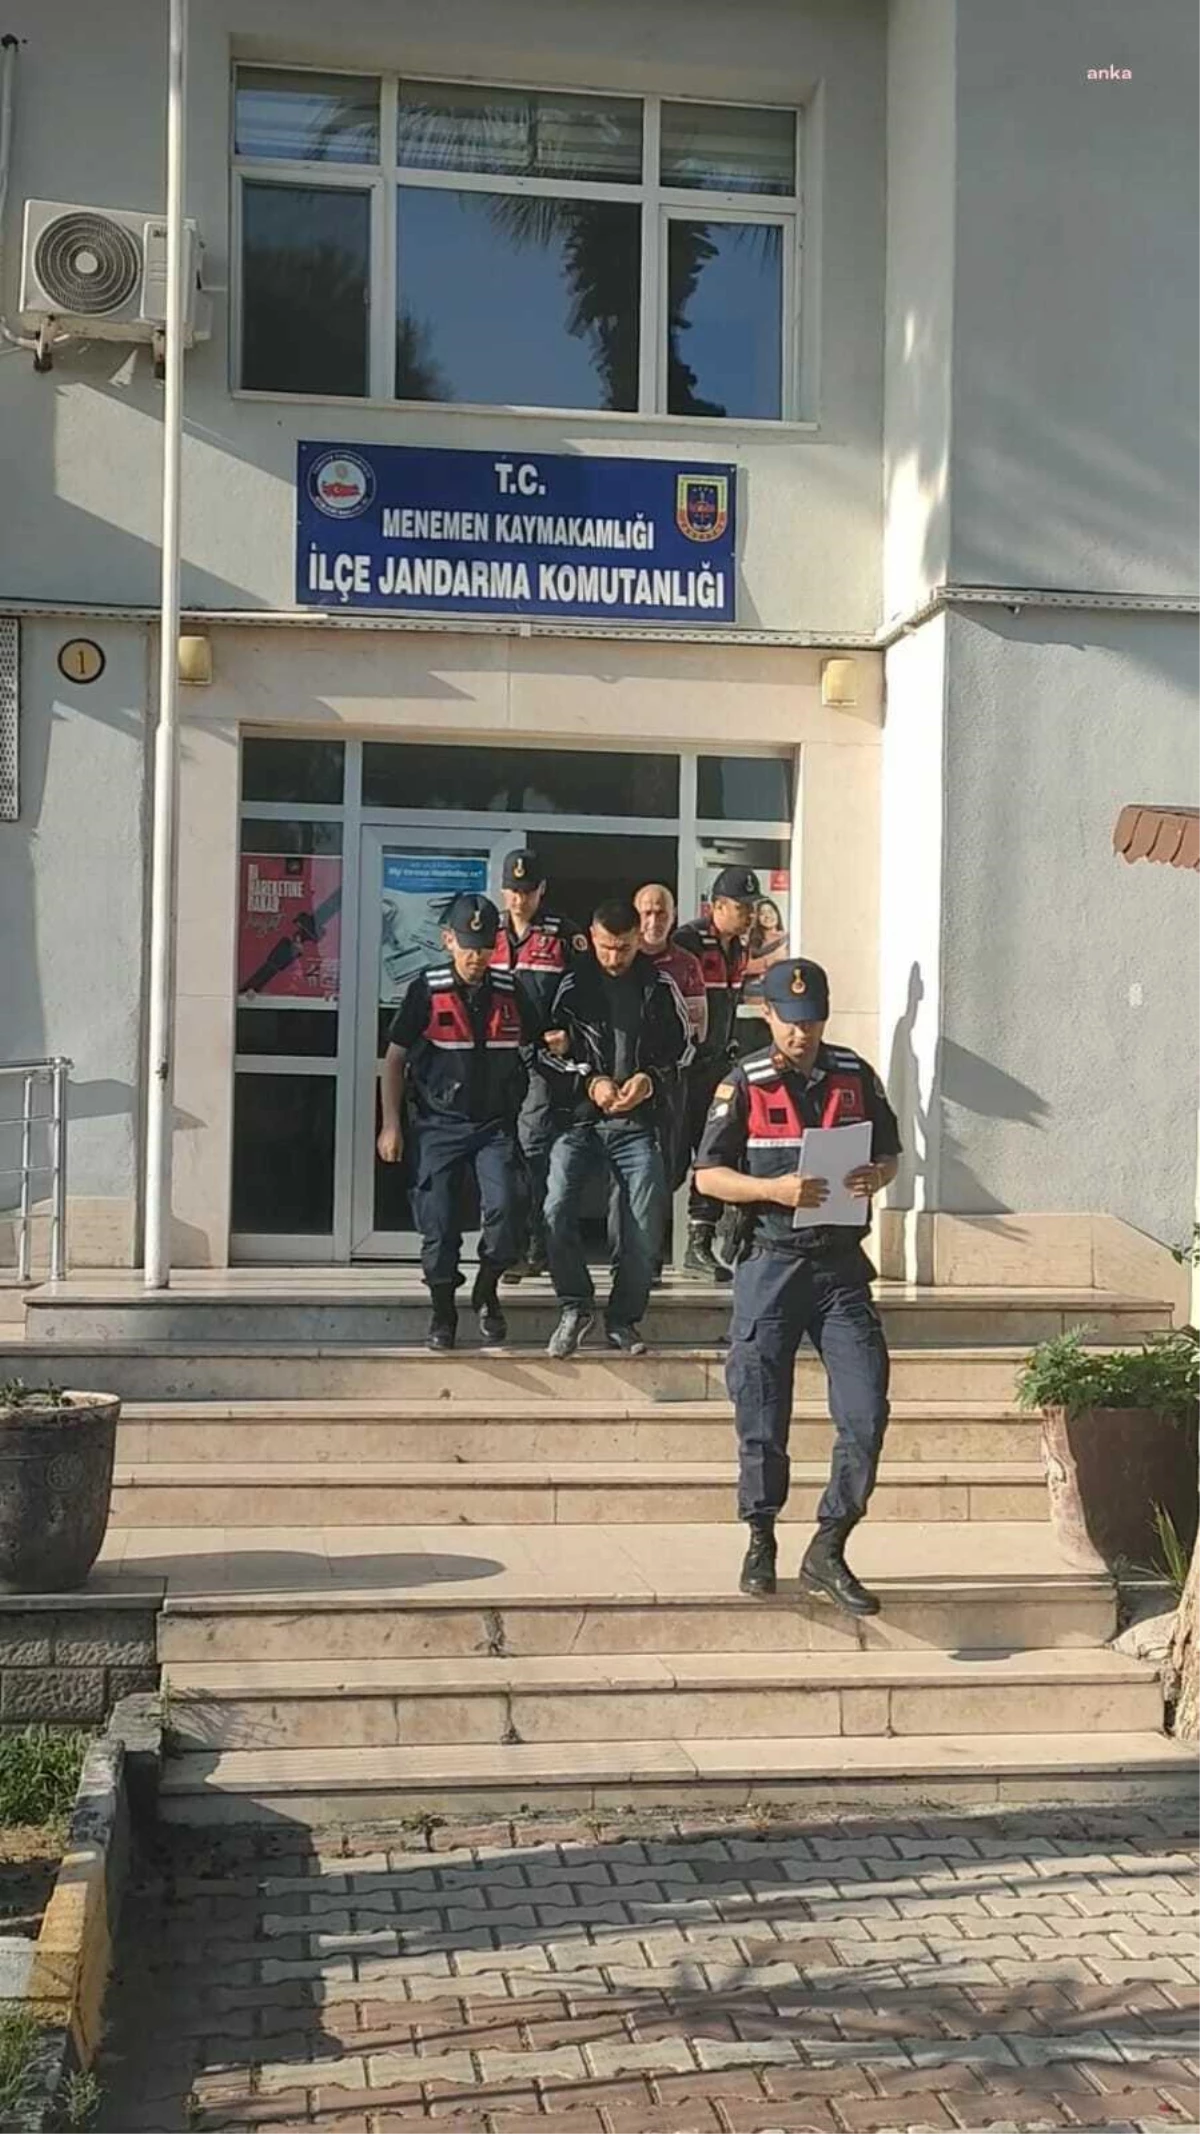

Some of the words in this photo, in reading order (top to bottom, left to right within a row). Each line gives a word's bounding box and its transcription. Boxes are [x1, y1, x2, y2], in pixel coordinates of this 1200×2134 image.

[494, 463, 546, 495] T.C.
[382, 508, 489, 541] MENEMEN
[495, 512, 654, 551] KAYMAKAMLIĞI
[309, 542, 371, 603] İLÇE
[378, 556, 531, 600] JANDARMA
[538, 560, 725, 609] KOMUTANLIĞI
[78, 650, 86, 675] 1
